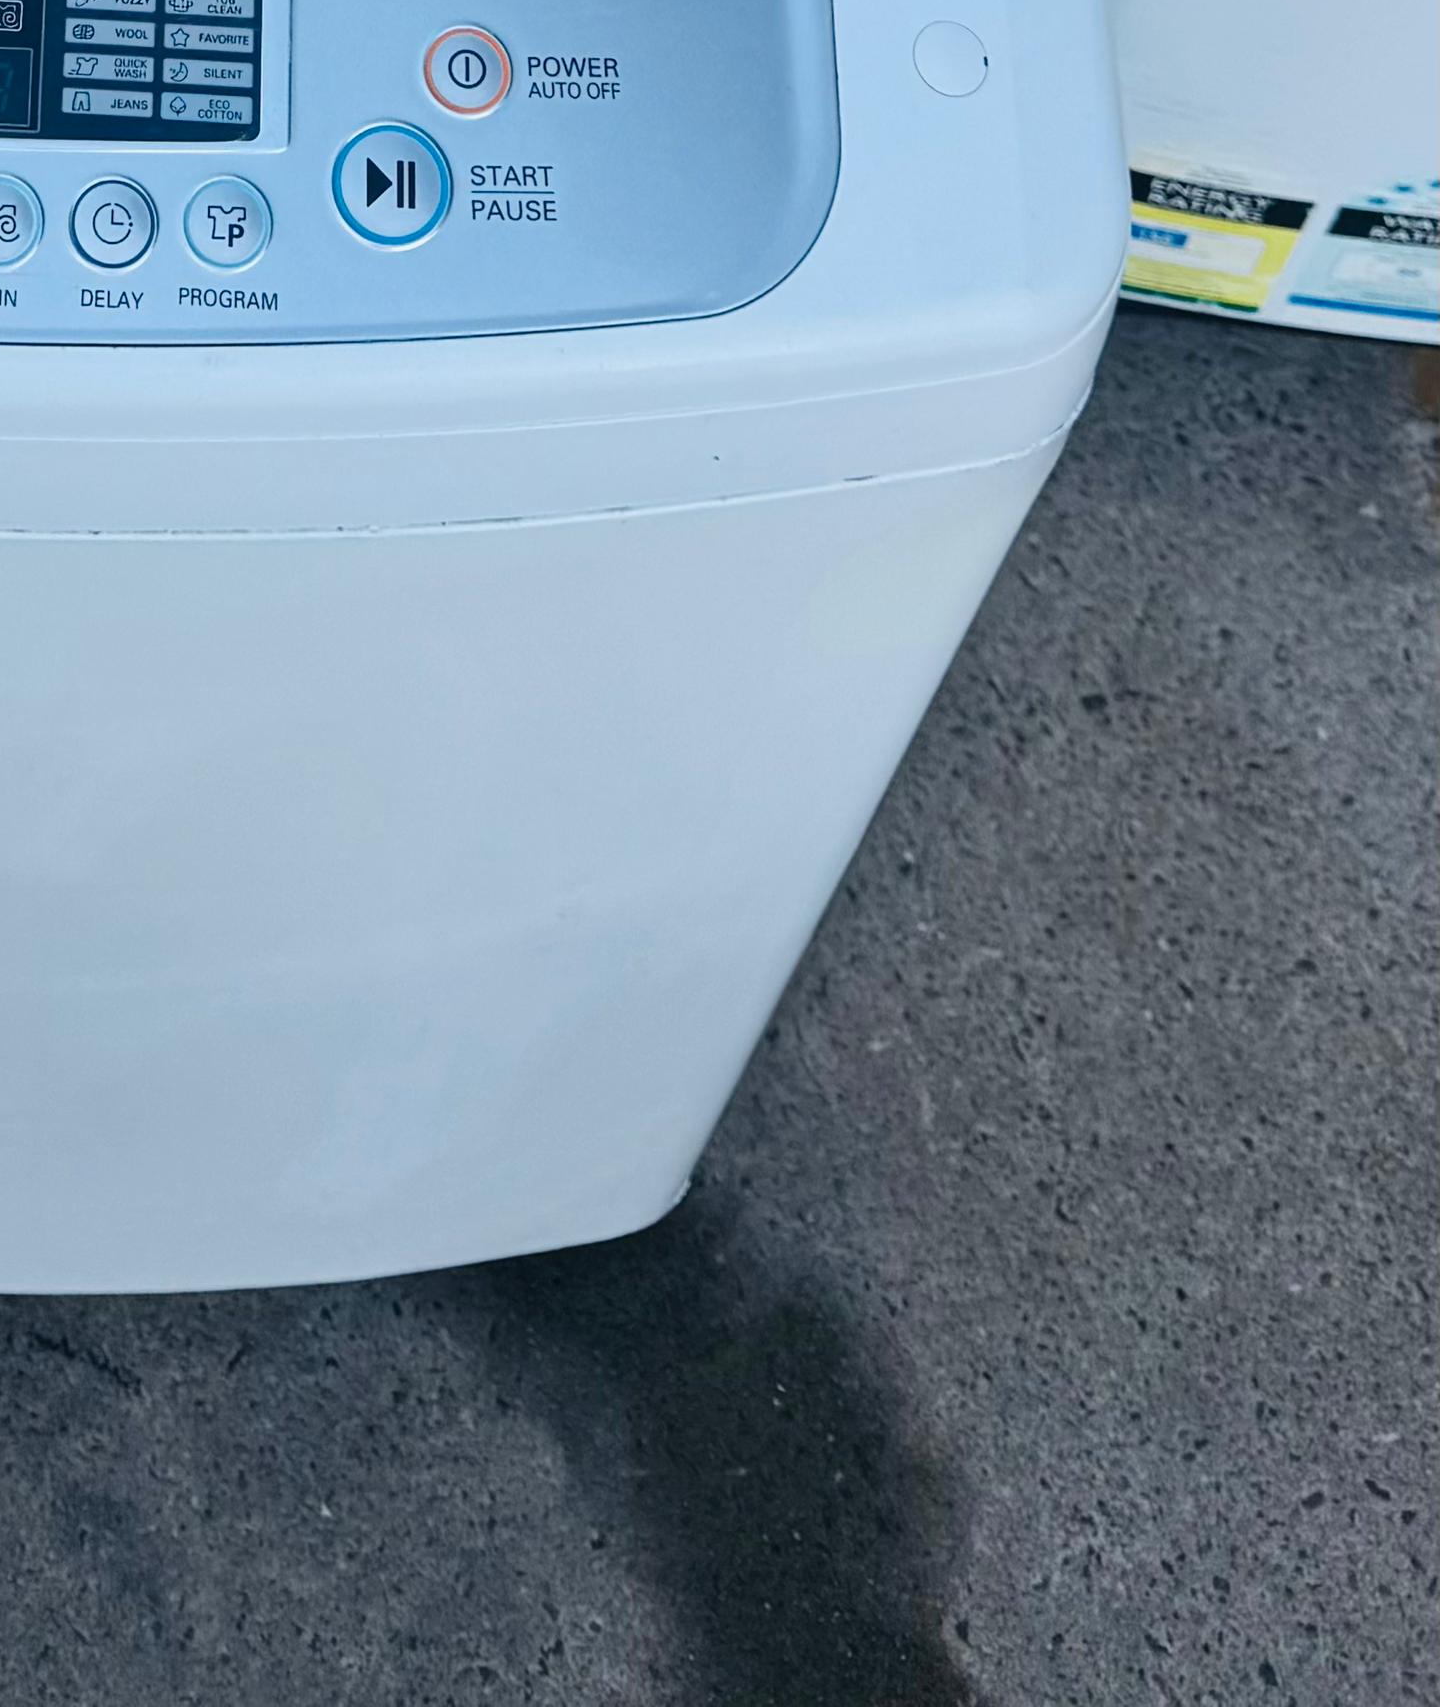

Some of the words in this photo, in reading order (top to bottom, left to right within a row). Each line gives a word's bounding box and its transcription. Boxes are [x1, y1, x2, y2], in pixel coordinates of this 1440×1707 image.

[207, 4, 242, 15] CLEAN
[115, 28, 148, 40] WOOL
[198, 32, 250, 46] FAVORITE
[114, 58, 148, 69] QUICK
[527, 56, 620, 79] POWER
[114, 69, 147, 79] WASH
[203, 68, 244, 79] SILENT
[528, 82, 582, 100] AUTO
[586, 82, 621, 100] OFF
[110, 98, 148, 111] JEANS
[209, 99, 231, 110] ECO
[198, 109, 243, 121] COTTON
[470, 165, 554, 187] START
[471, 199, 558, 221] PAUSE
[80, 289, 145, 310] DELAY
[178, 287, 279, 311] PROGRAM
